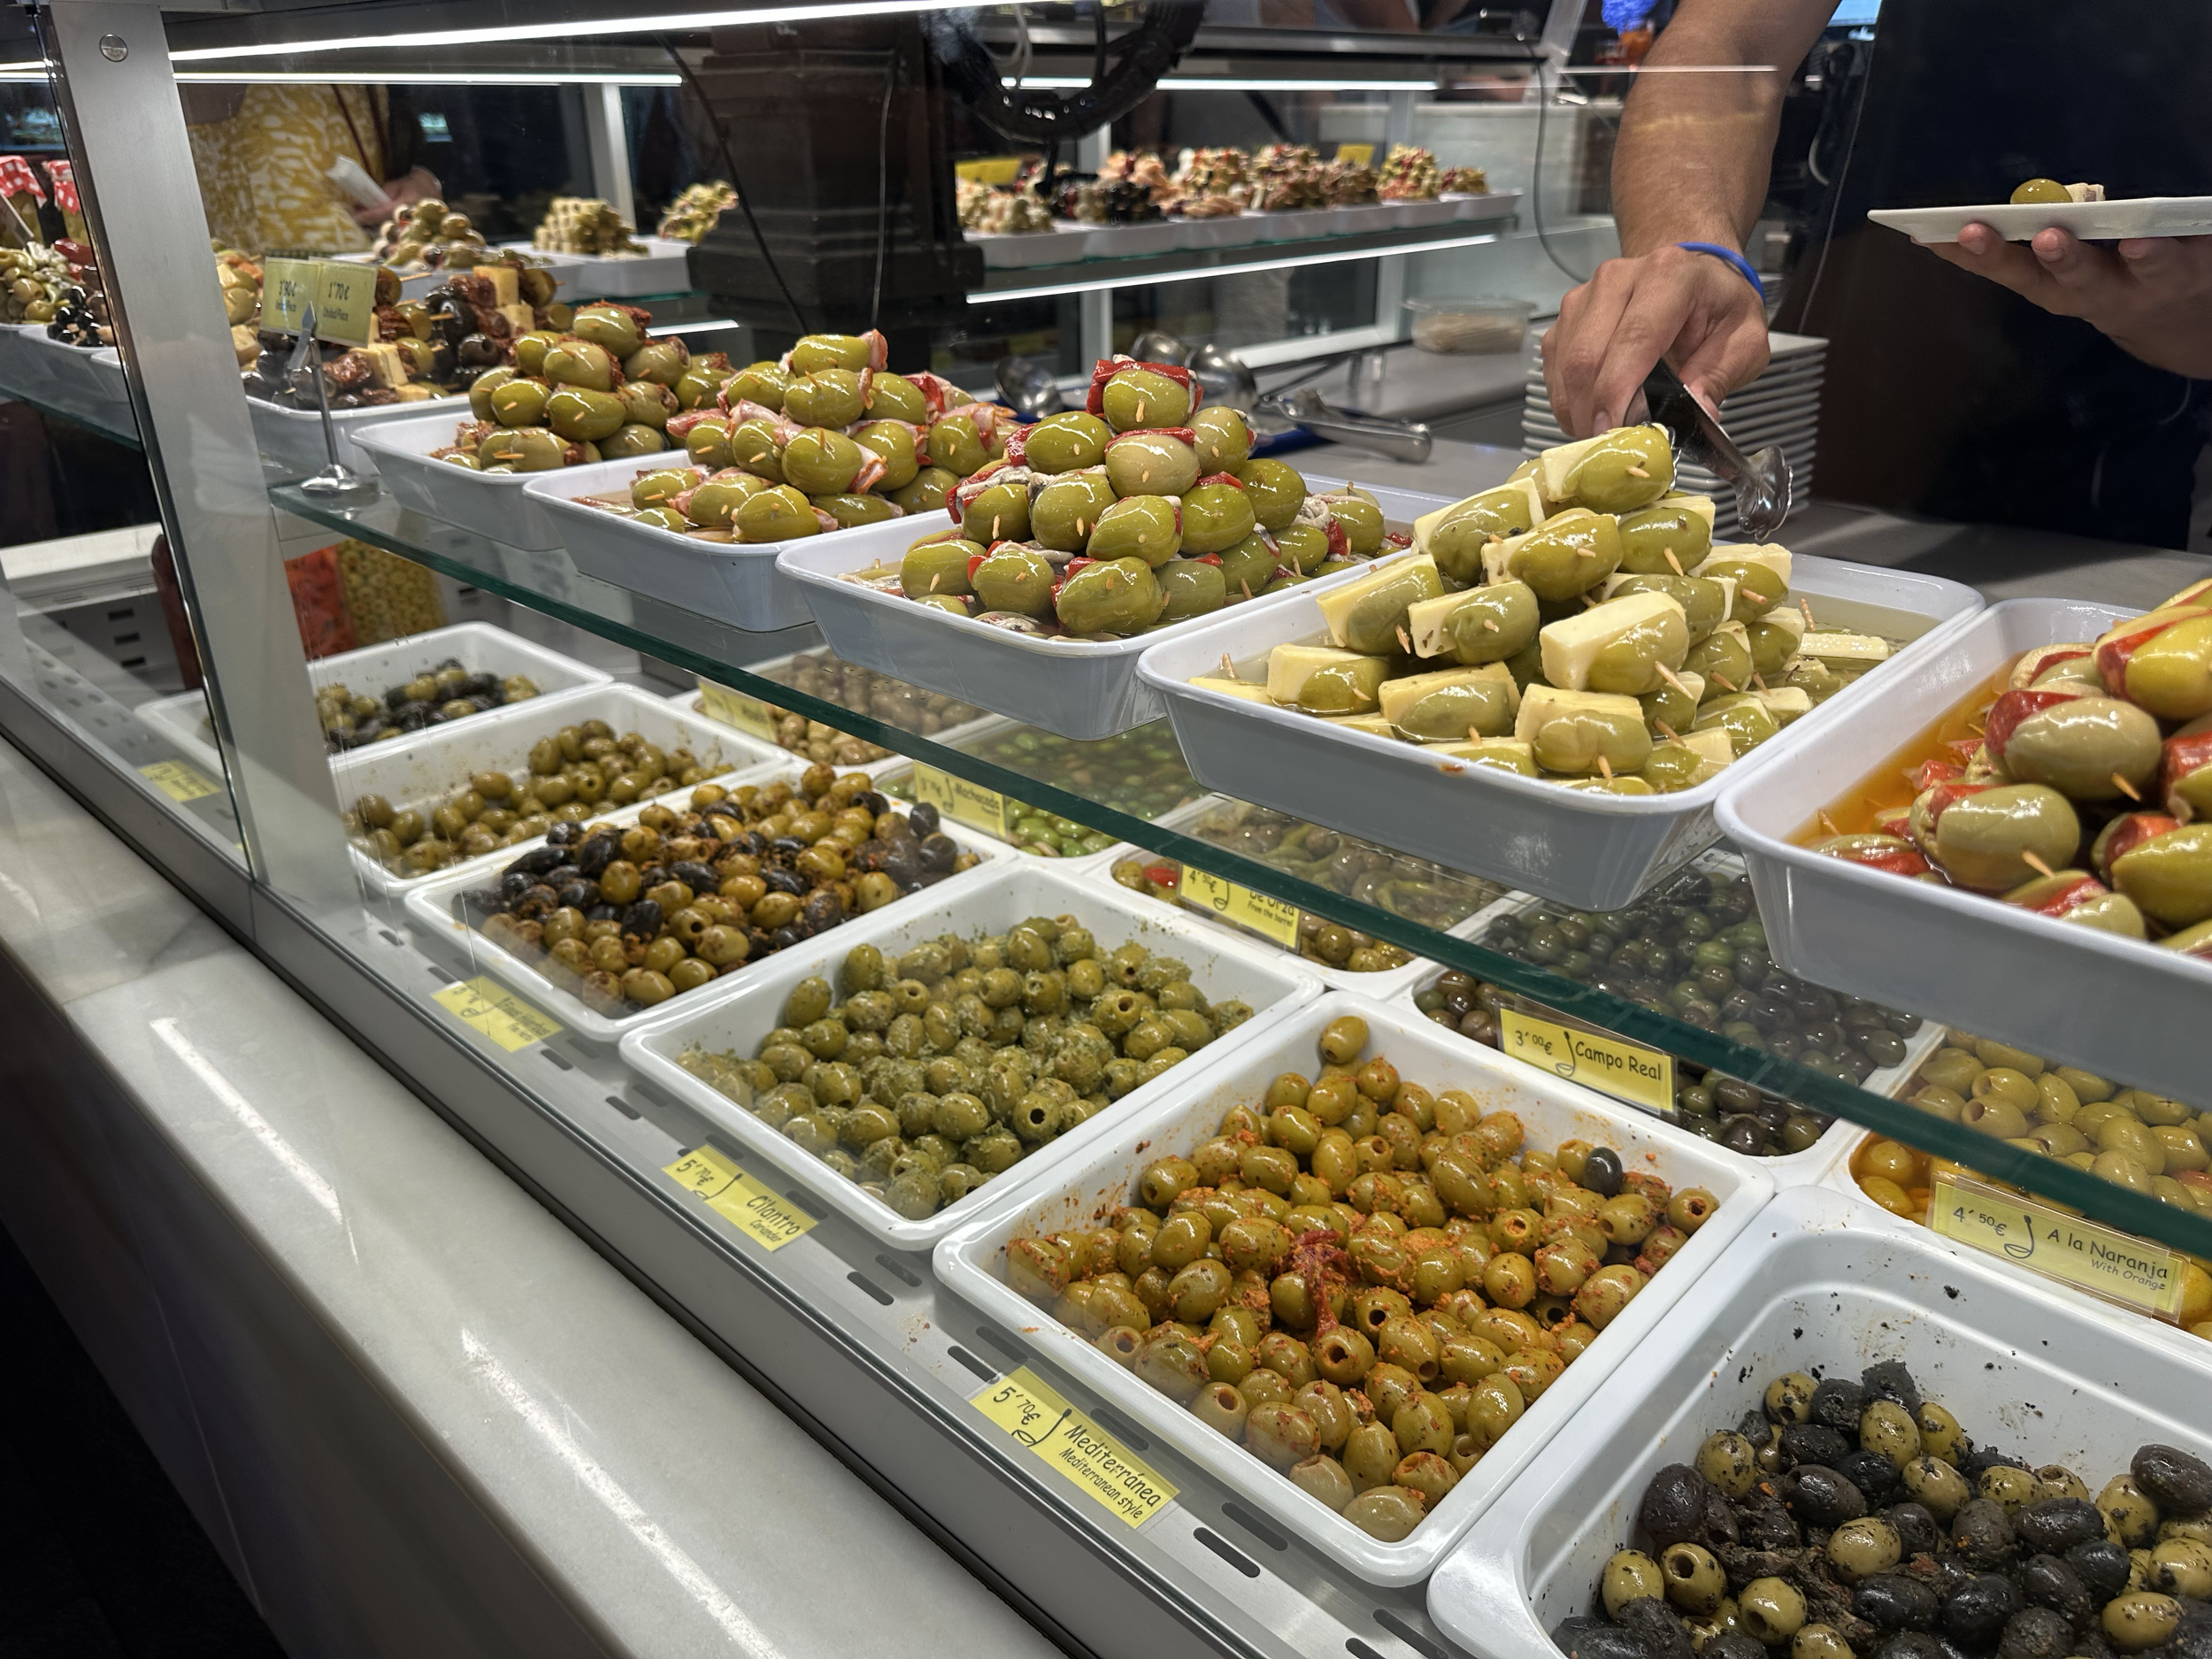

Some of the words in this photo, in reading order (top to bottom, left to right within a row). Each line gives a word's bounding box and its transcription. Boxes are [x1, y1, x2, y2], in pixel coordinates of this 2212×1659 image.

[1248, 900, 1263, 914] From
[1263, 908, 1273, 919] the
[1274, 912, 1294, 927] barrel
[1574, 1041, 1623, 1071] Campo
[1628, 1055, 1662, 1081] Real
[746, 1194, 802, 1236] Cilantro
[749, 1219, 782, 1242] Coriander
[2047, 1228, 2060, 1244] A
[2067, 1233, 2084, 1252] la
[2089, 1240, 2168, 1279] Naranja
[2091, 1258, 2119, 1276] With
[2123, 1270, 2166, 1291] Orange
[1058, 1447, 1121, 1501] Mediterranean
[1117, 1495, 1144, 1520] style
[1064, 1424, 1162, 1509] Mediterránea
